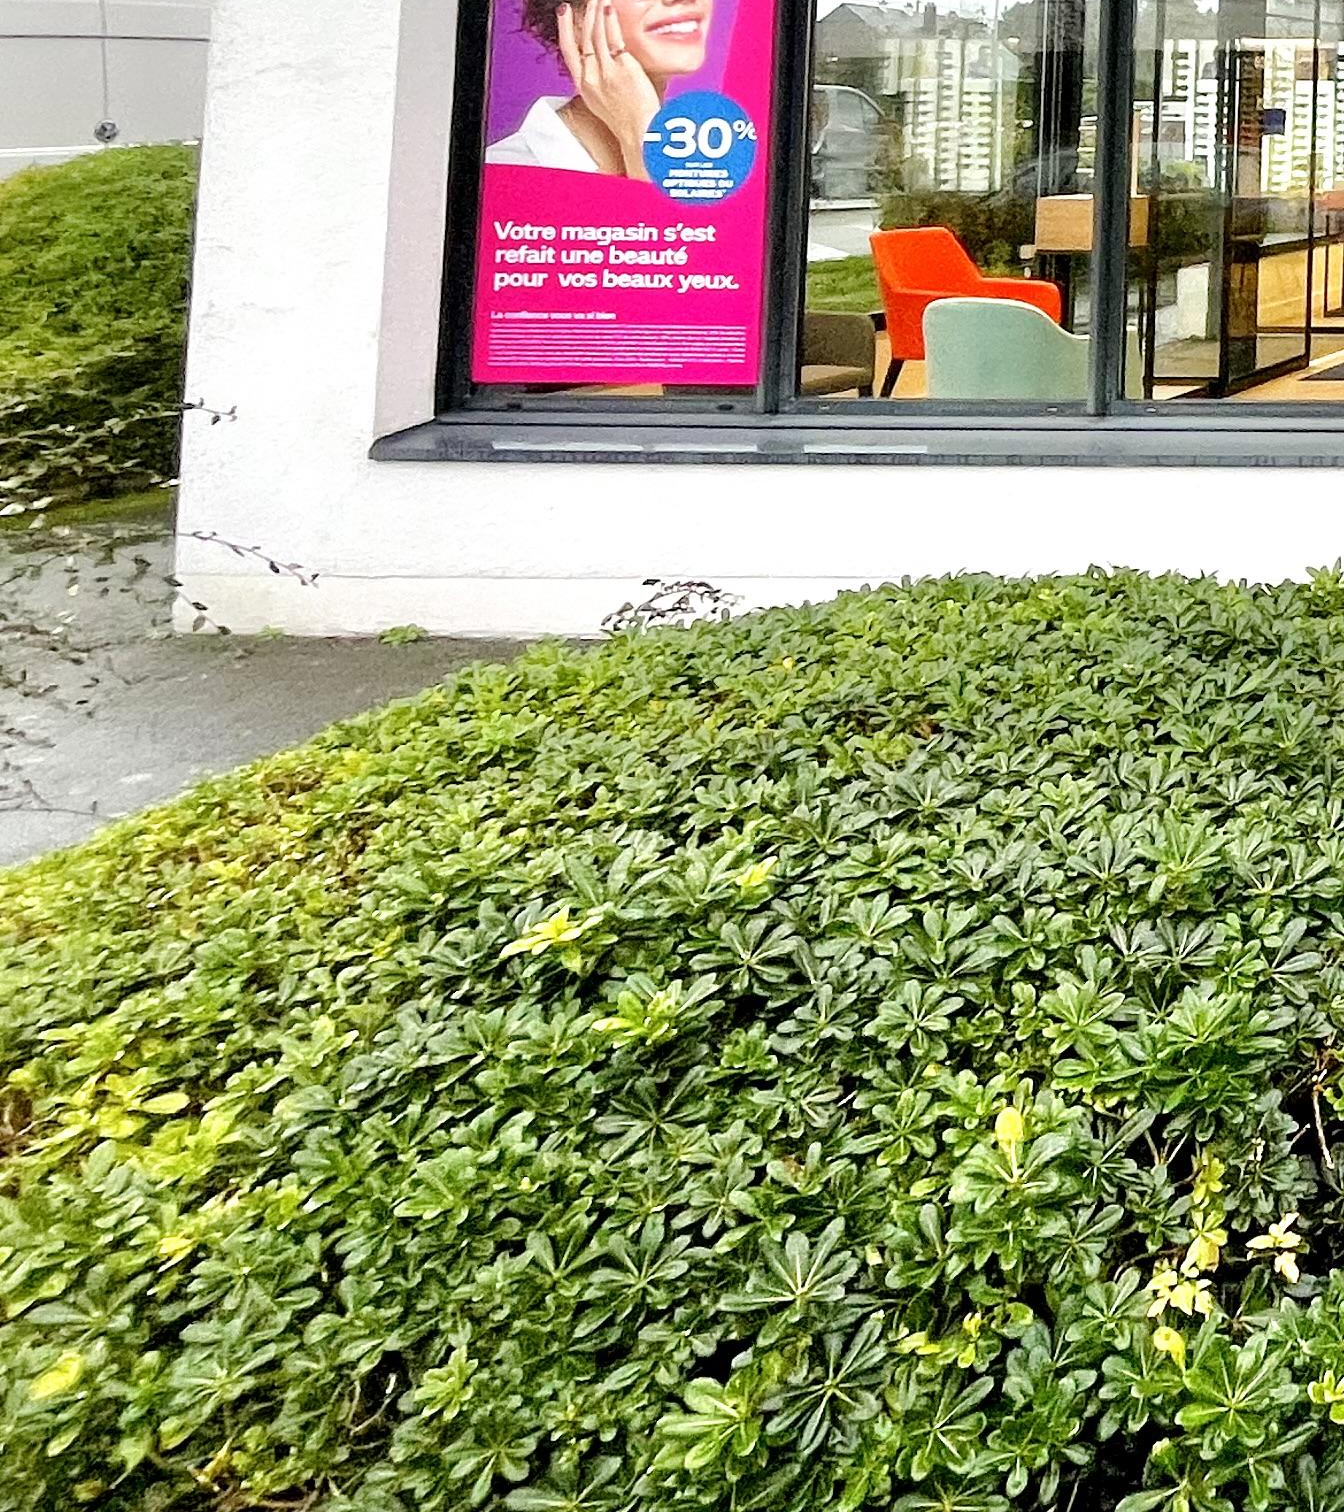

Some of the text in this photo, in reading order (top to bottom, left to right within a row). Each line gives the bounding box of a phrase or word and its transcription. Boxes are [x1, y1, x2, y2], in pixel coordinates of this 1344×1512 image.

[641, 117, 758, 159] -30%
[494, 221, 716, 245] Votre magasin s'est
[494, 245, 688, 265] refait une beauté
[493, 269, 739, 293] pour vos beaux yeux.
